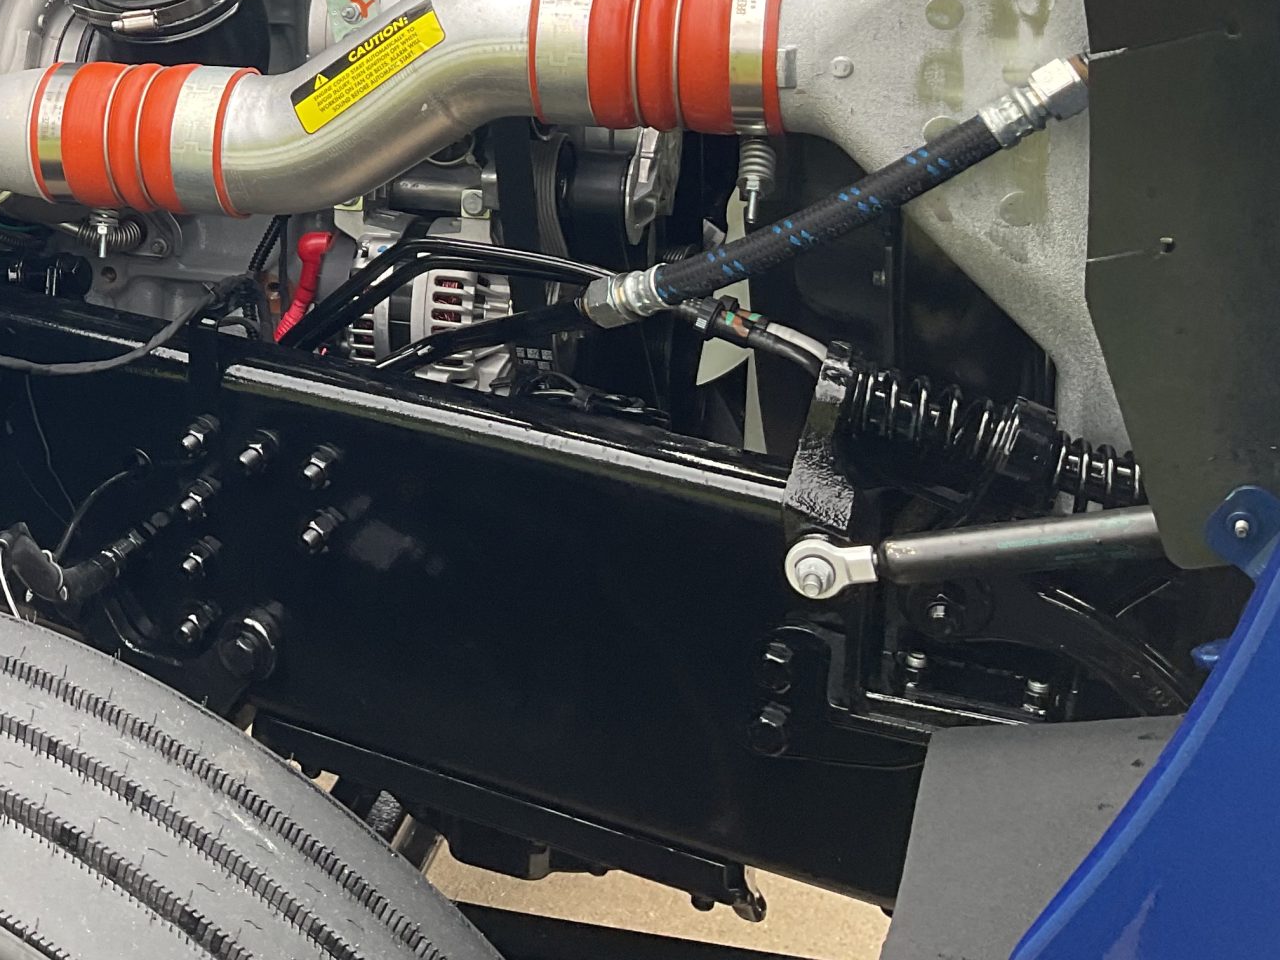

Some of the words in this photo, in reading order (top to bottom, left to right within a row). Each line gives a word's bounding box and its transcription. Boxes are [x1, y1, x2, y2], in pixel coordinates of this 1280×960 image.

[314, 85, 332, 101] ENGINE
[334, 72, 350, 86] COULD
[351, 62, 365, 74] START
[407, 26, 415, 34] TO
[317, 93, 332, 106] AVOID
[352, 70, 366, 81] TURN
[366, 51, 390, 70] IGNITION
[390, 44, 400, 54] OFF
[400, 32, 418, 46] WHEN
[320, 93, 344, 112] WORKING
[345, 86, 354, 94] ON
[355, 79, 366, 88] FAN
[366, 71, 373, 80] OR
[390, 48, 408, 62] ALARM
[408, 39, 421, 49] WILL
[348, 16, 408, 62] CAUTION:
[332, 97, 351, 112] SOUND
[351, 84, 370, 100] BEFORE
[370, 62, 400, 86] AUTOMATIC
